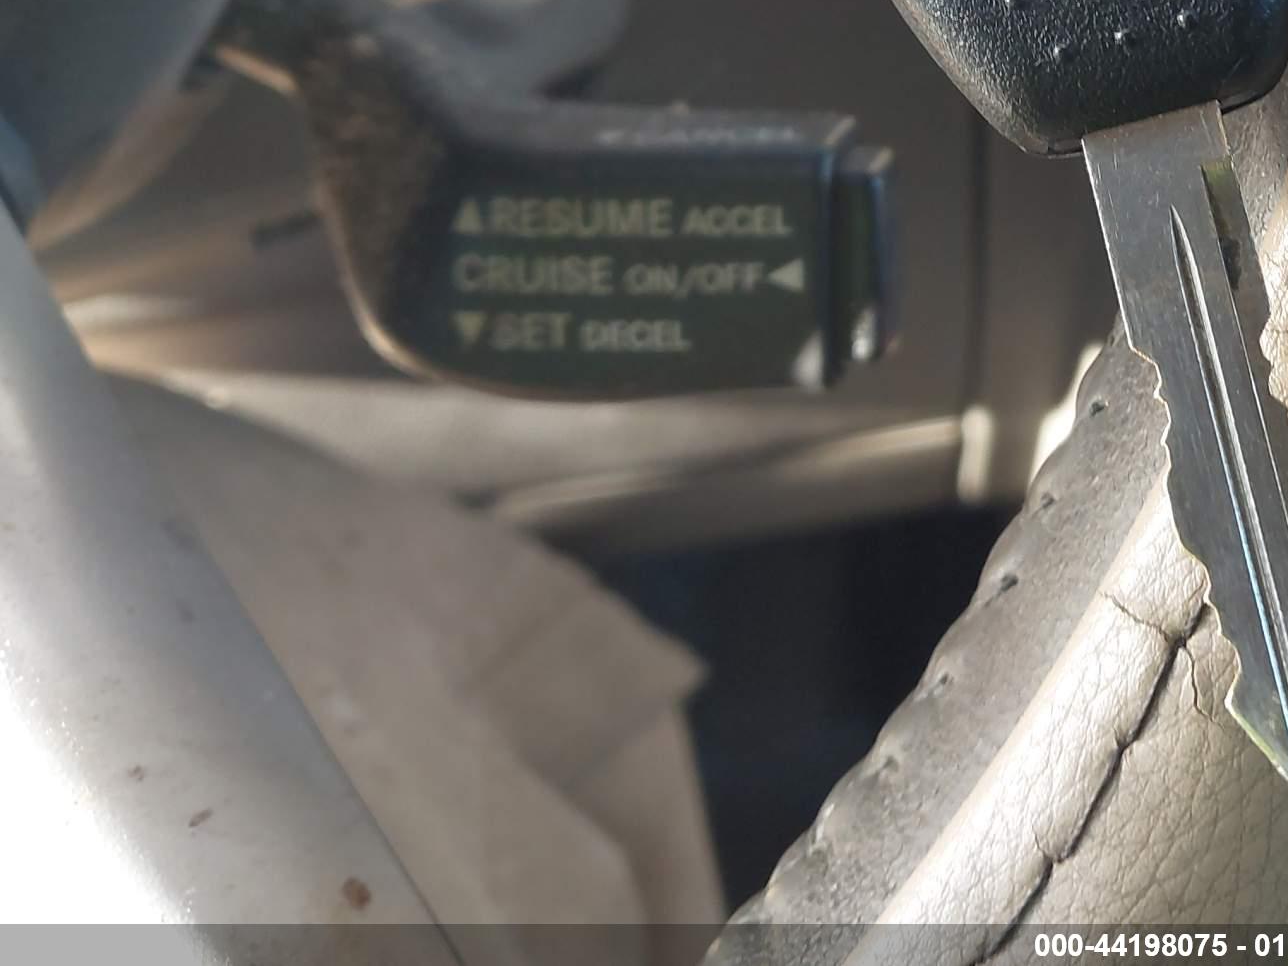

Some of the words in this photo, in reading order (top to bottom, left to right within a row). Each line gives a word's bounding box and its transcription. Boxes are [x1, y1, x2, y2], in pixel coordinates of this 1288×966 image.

[489, 196, 674, 236] RESUME
[682, 205, 794, 236] ACCEL
[452, 253, 614, 294] CRUISE
[622, 262, 764, 299] ON/OFF
[491, 311, 572, 351] SET
[579, 319, 692, 351] DECEL
